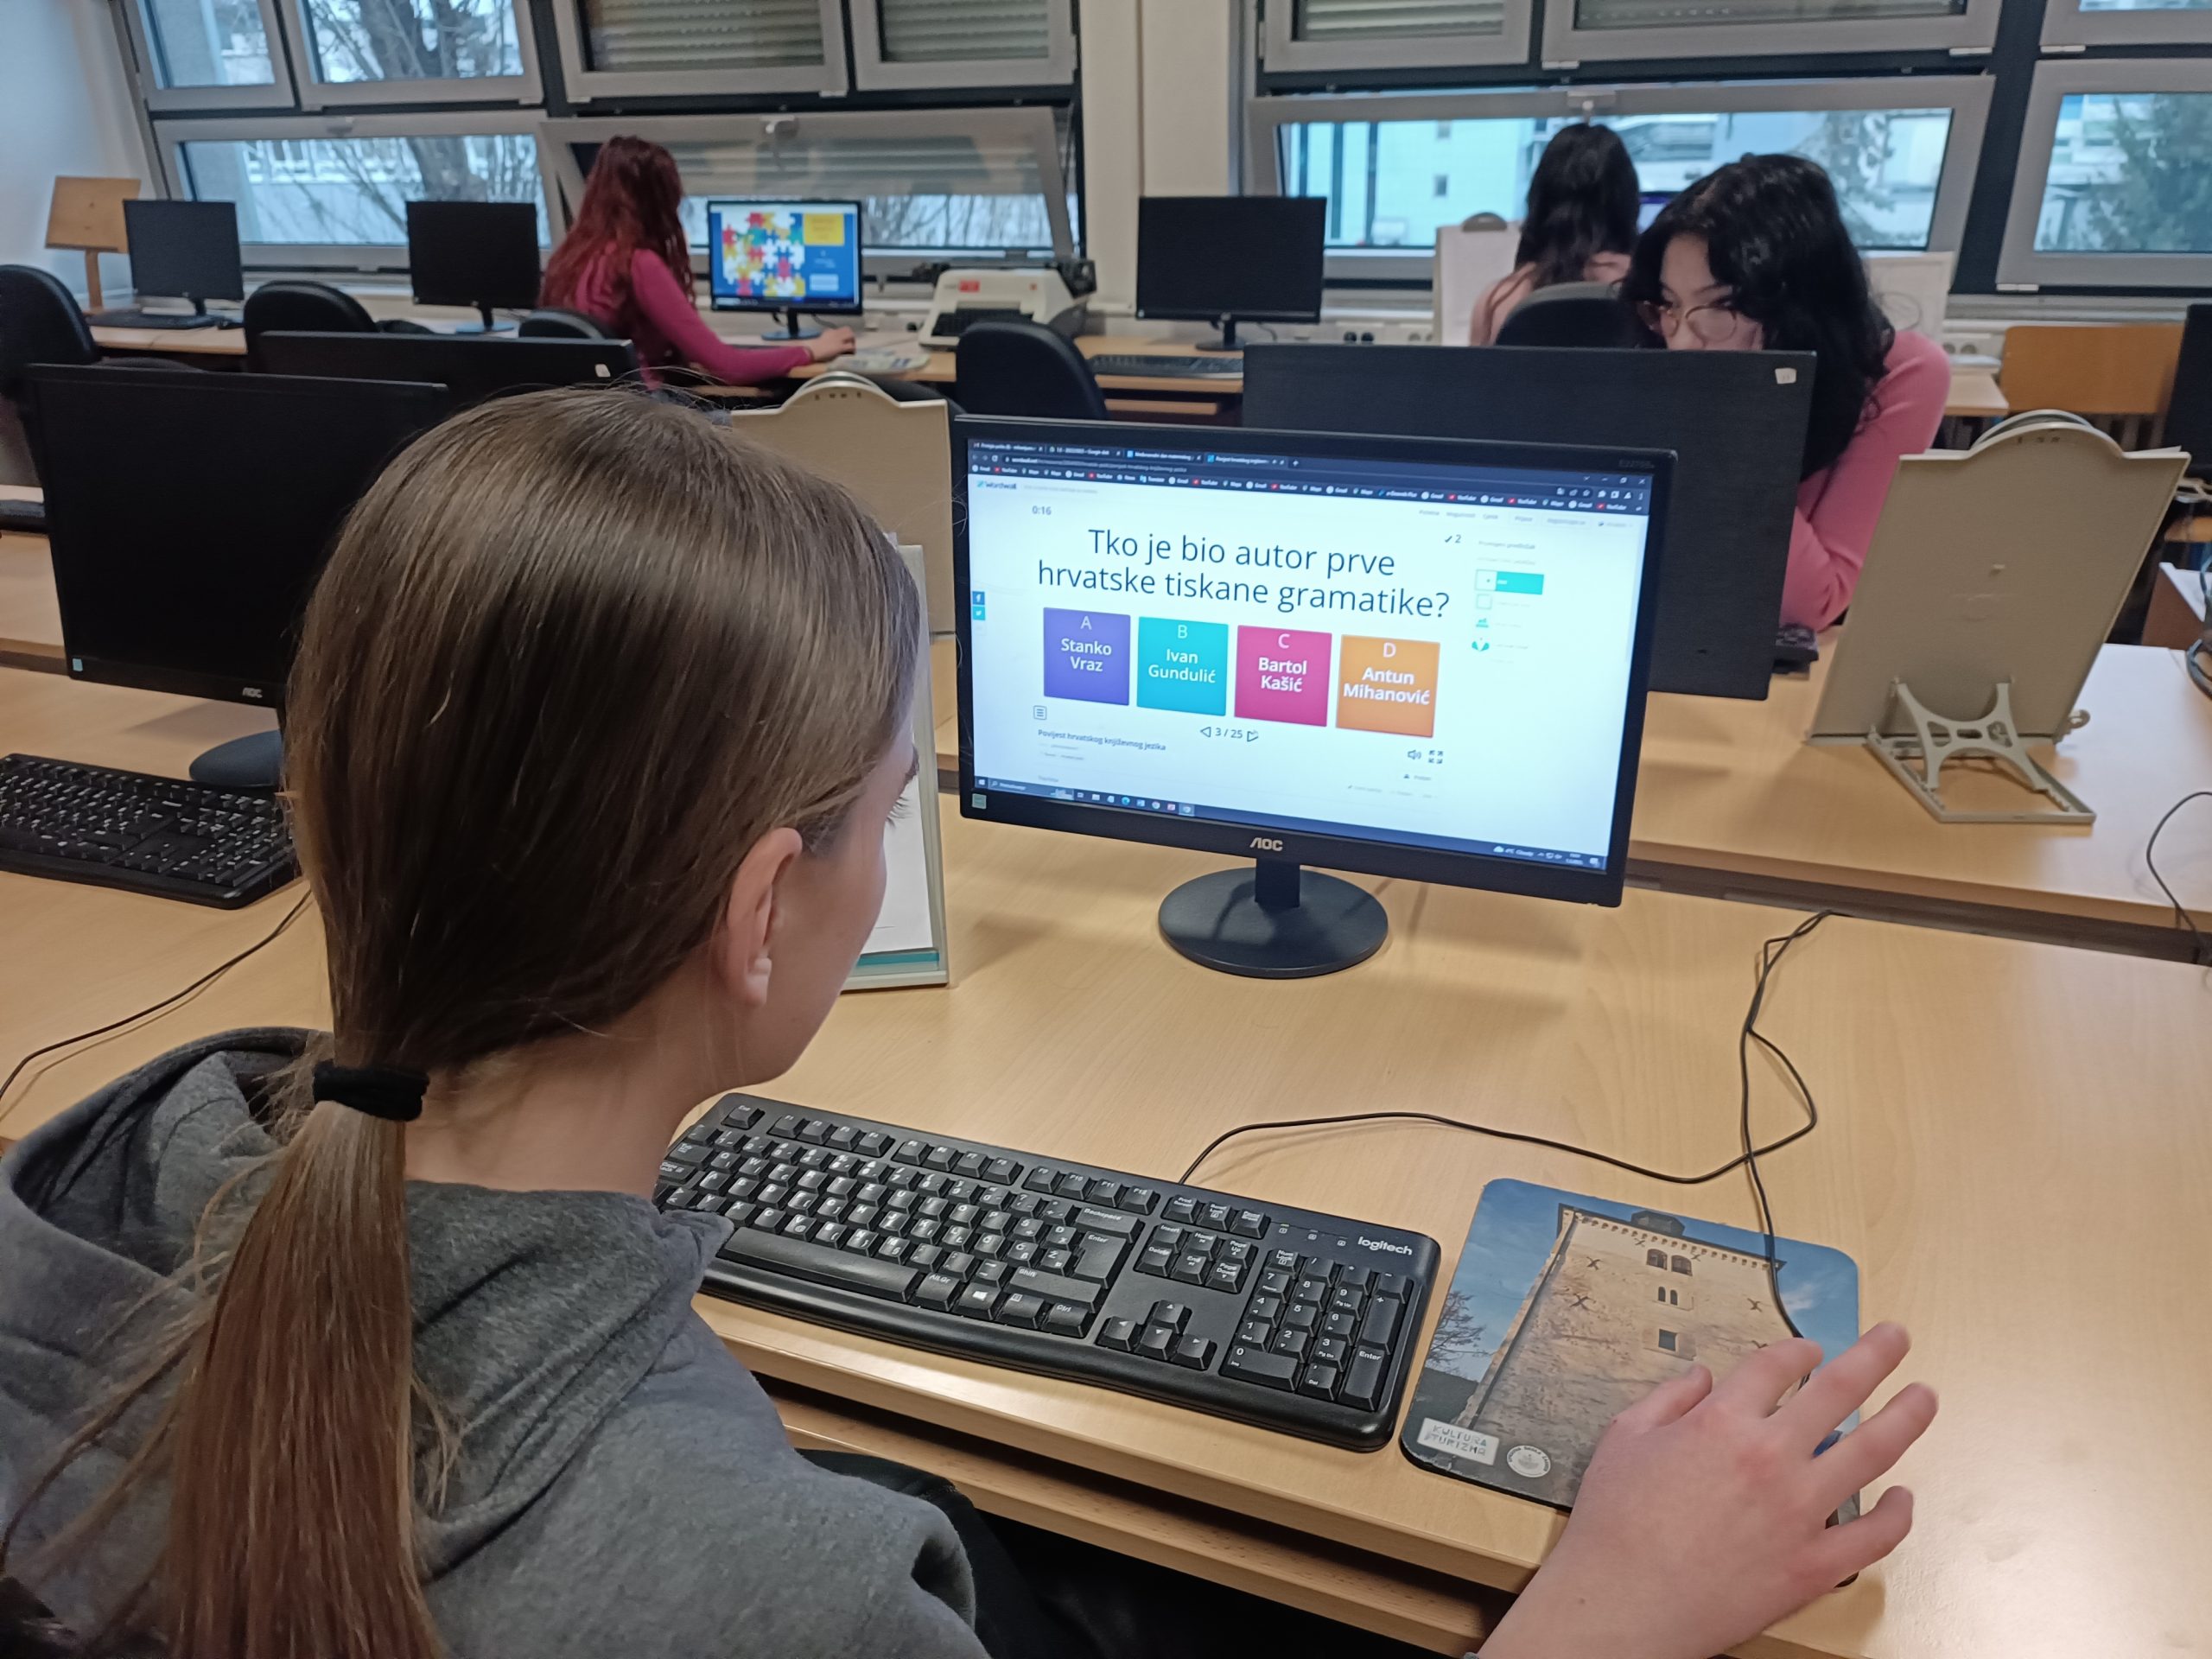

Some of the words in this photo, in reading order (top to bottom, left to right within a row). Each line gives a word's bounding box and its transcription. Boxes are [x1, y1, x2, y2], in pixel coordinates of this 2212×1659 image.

[1032, 505, 1052, 515] 0:16
[1454, 534, 1462, 543] 2
[1088, 529, 1138, 556] Tko
[1145, 533, 1171, 565] je
[1182, 535, 1225, 563] bio
[1236, 544, 1318, 569] autor
[1327, 551, 1395, 579] prve
[1039, 559, 1155, 594] hrvatske
[1165, 571, 1268, 603] tiskane
[1277, 585, 1450, 618] gramatike?
[1080, 615, 1092, 630] A
[1178, 624, 1188, 639] B
[1060, 638, 1112, 656] Stanko
[1278, 633, 1290, 649] C
[1166, 648, 1198, 664] Ivan
[1382, 642, 1396, 658] D
[1070, 656, 1103, 672] Vraz
[1258, 657, 1307, 675] Bartol
[1148, 664, 1217, 683] Gundulić
[1362, 667, 1414, 685] Antun
[1261, 674, 1303, 692] Kašić
[1343, 683, 1431, 705] Mihanović
[1038, 729, 1066, 739] Povijest
[1067, 733, 1103, 745] hrvatskog
[1144, 742, 1166, 751] jezika
[1215, 728, 1221, 736] 3
[1230, 729, 1243, 739] 25
[1249, 837, 1283, 852] AOC
[1088, 1234, 1109, 1243] Enter
[1357, 1236, 1413, 1255] logitech
[1019, 1268, 1037, 1278] Shift
[1359, 1351, 1382, 1361] Enter
